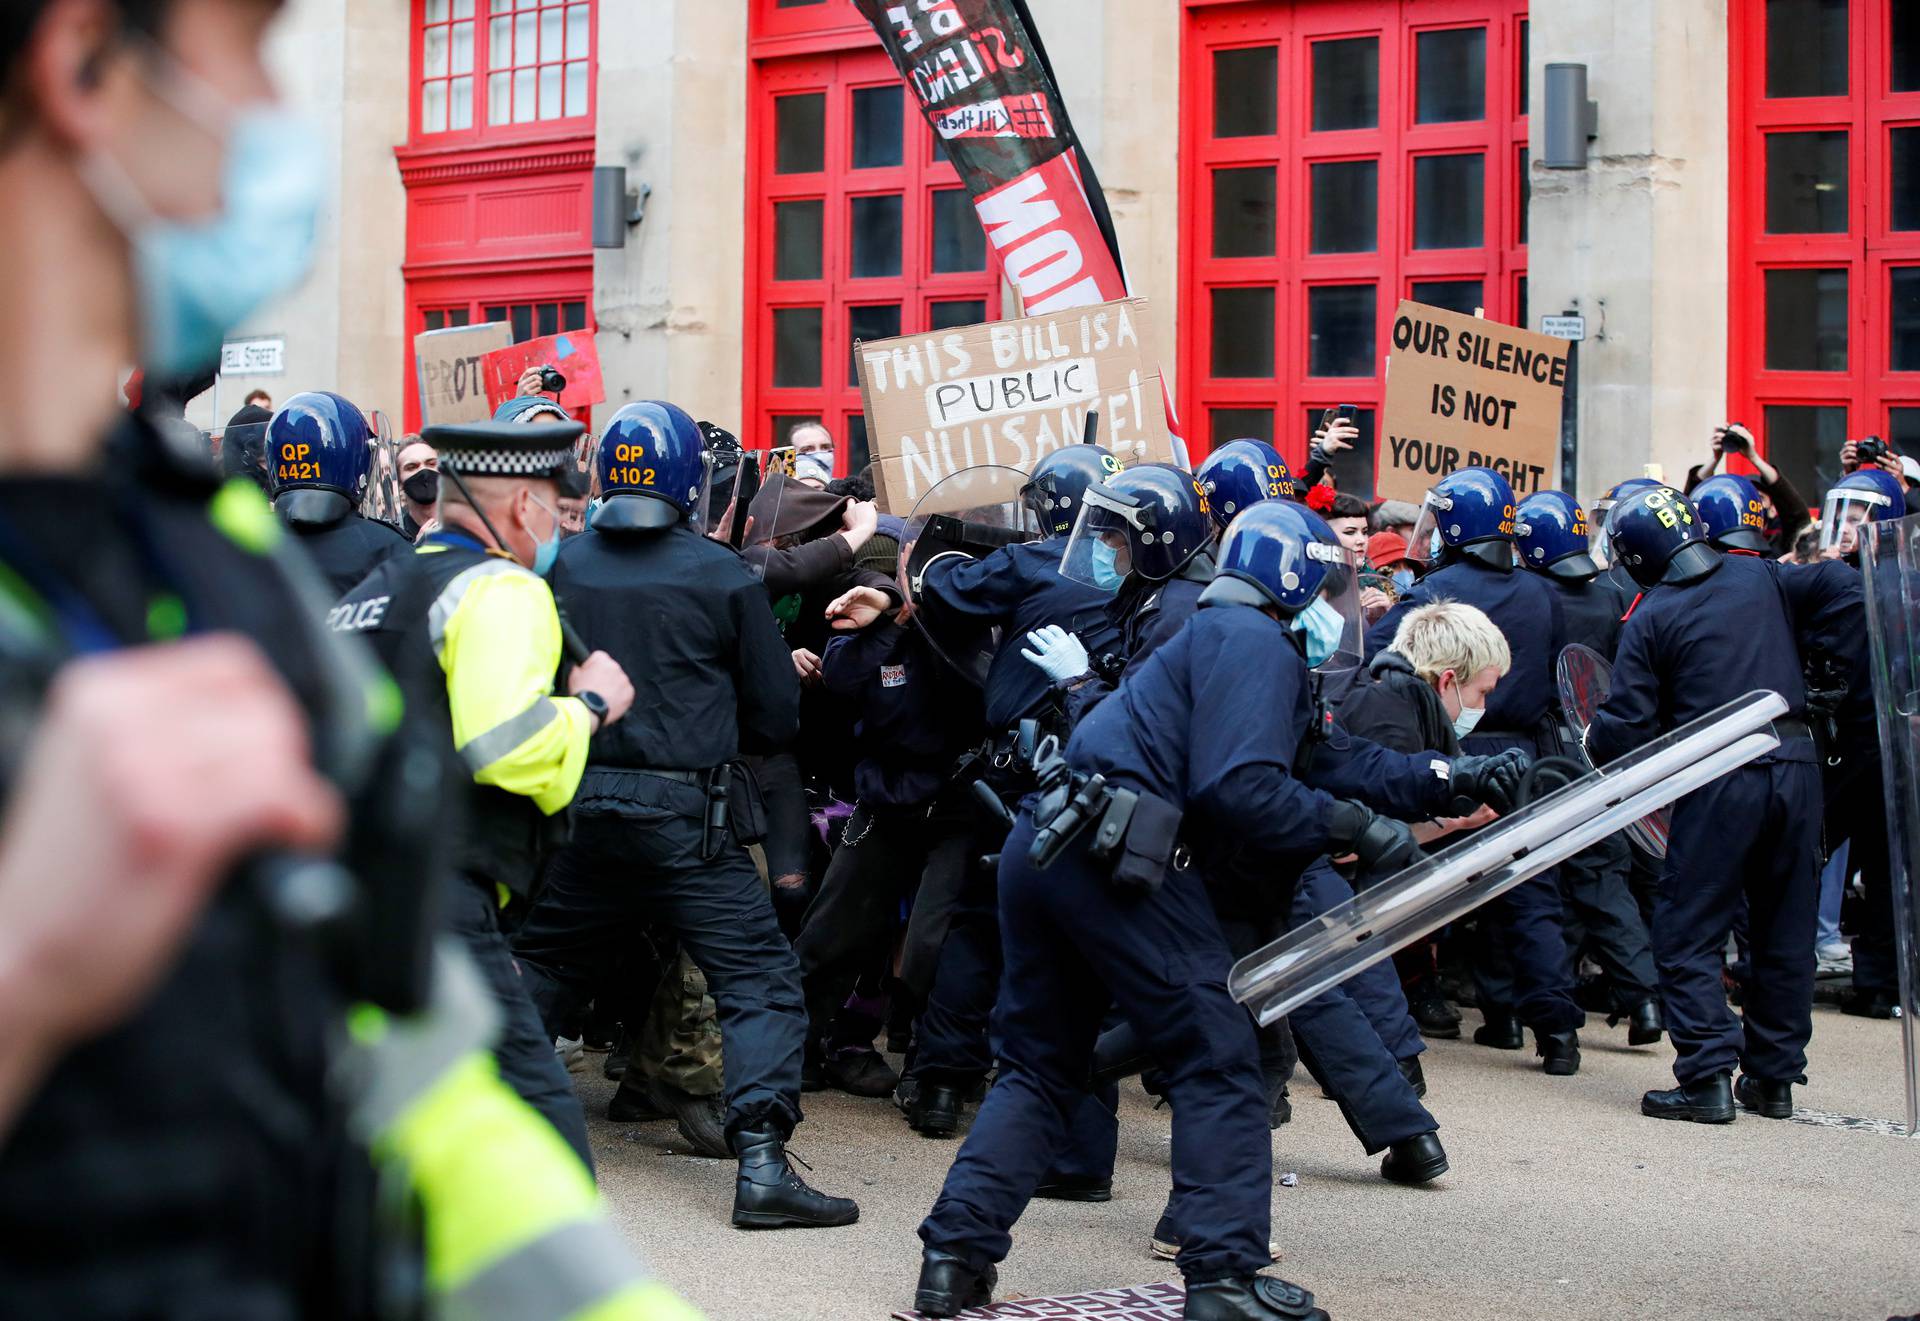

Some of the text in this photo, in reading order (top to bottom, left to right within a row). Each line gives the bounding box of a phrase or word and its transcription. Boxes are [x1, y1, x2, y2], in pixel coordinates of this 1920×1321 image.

[863, 305, 1138, 394] THIS BILL IS A
[1392, 315, 1567, 388] OUR SILENCE
[424, 356, 486, 407] PROT
[935, 364, 1083, 421] PUBLIC
[1431, 383, 1517, 430] IS NOT
[278, 461, 322, 480] 4421
[281, 443, 311, 462] QP
[615, 444, 644, 463] QP
[1389, 436, 1460, 477] YOUR
[609, 467, 656, 486] 4102
[1267, 464, 1287, 479] QP
[1645, 487, 1674, 509] QP
[326, 595, 391, 632] POLICE
